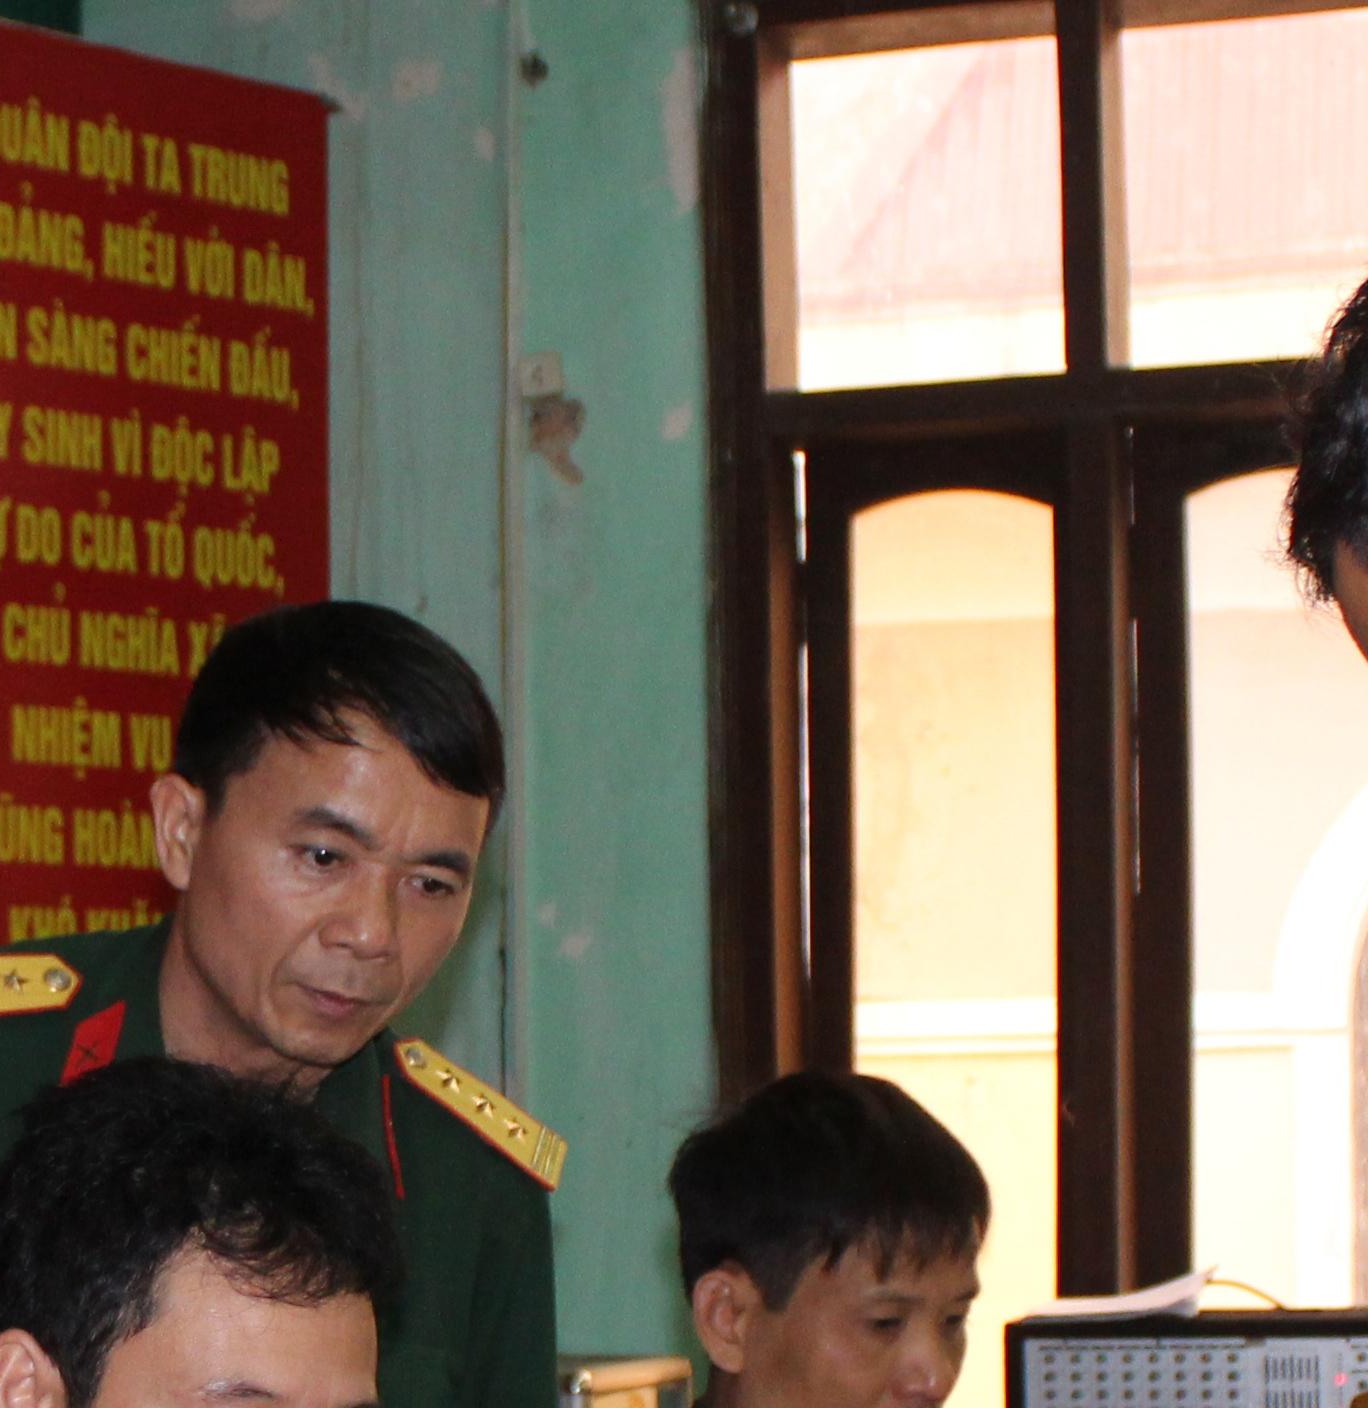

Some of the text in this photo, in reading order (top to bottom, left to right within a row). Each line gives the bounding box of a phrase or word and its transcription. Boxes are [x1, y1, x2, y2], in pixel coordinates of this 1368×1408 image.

[78, 112, 133, 195] ĐỘI
[141, 133, 181, 195] TA
[189, 142, 290, 216] TRUNG
[103, 210, 177, 290] HIẾU
[184, 225, 235, 298] VỚI
[243, 240, 315, 318] DÂN,
[27, 298, 118, 378] SÀNG
[126, 314, 222, 392] CHIẾN
[22, 405, 103, 473] SINH
[110, 406, 142, 476] VÌ
[150, 415, 215, 498] ĐỘC
[222, 424, 281, 507] LẬP
[16, 503, 62, 566] DO
[70, 489, 137, 575] CỦA
[144, 500, 185, 580] TỔ
[2, 582, 72, 667] CHỦ
[79, 607, 180, 677] NGHĨA
[11, 695, 122, 781] NHIỆM
